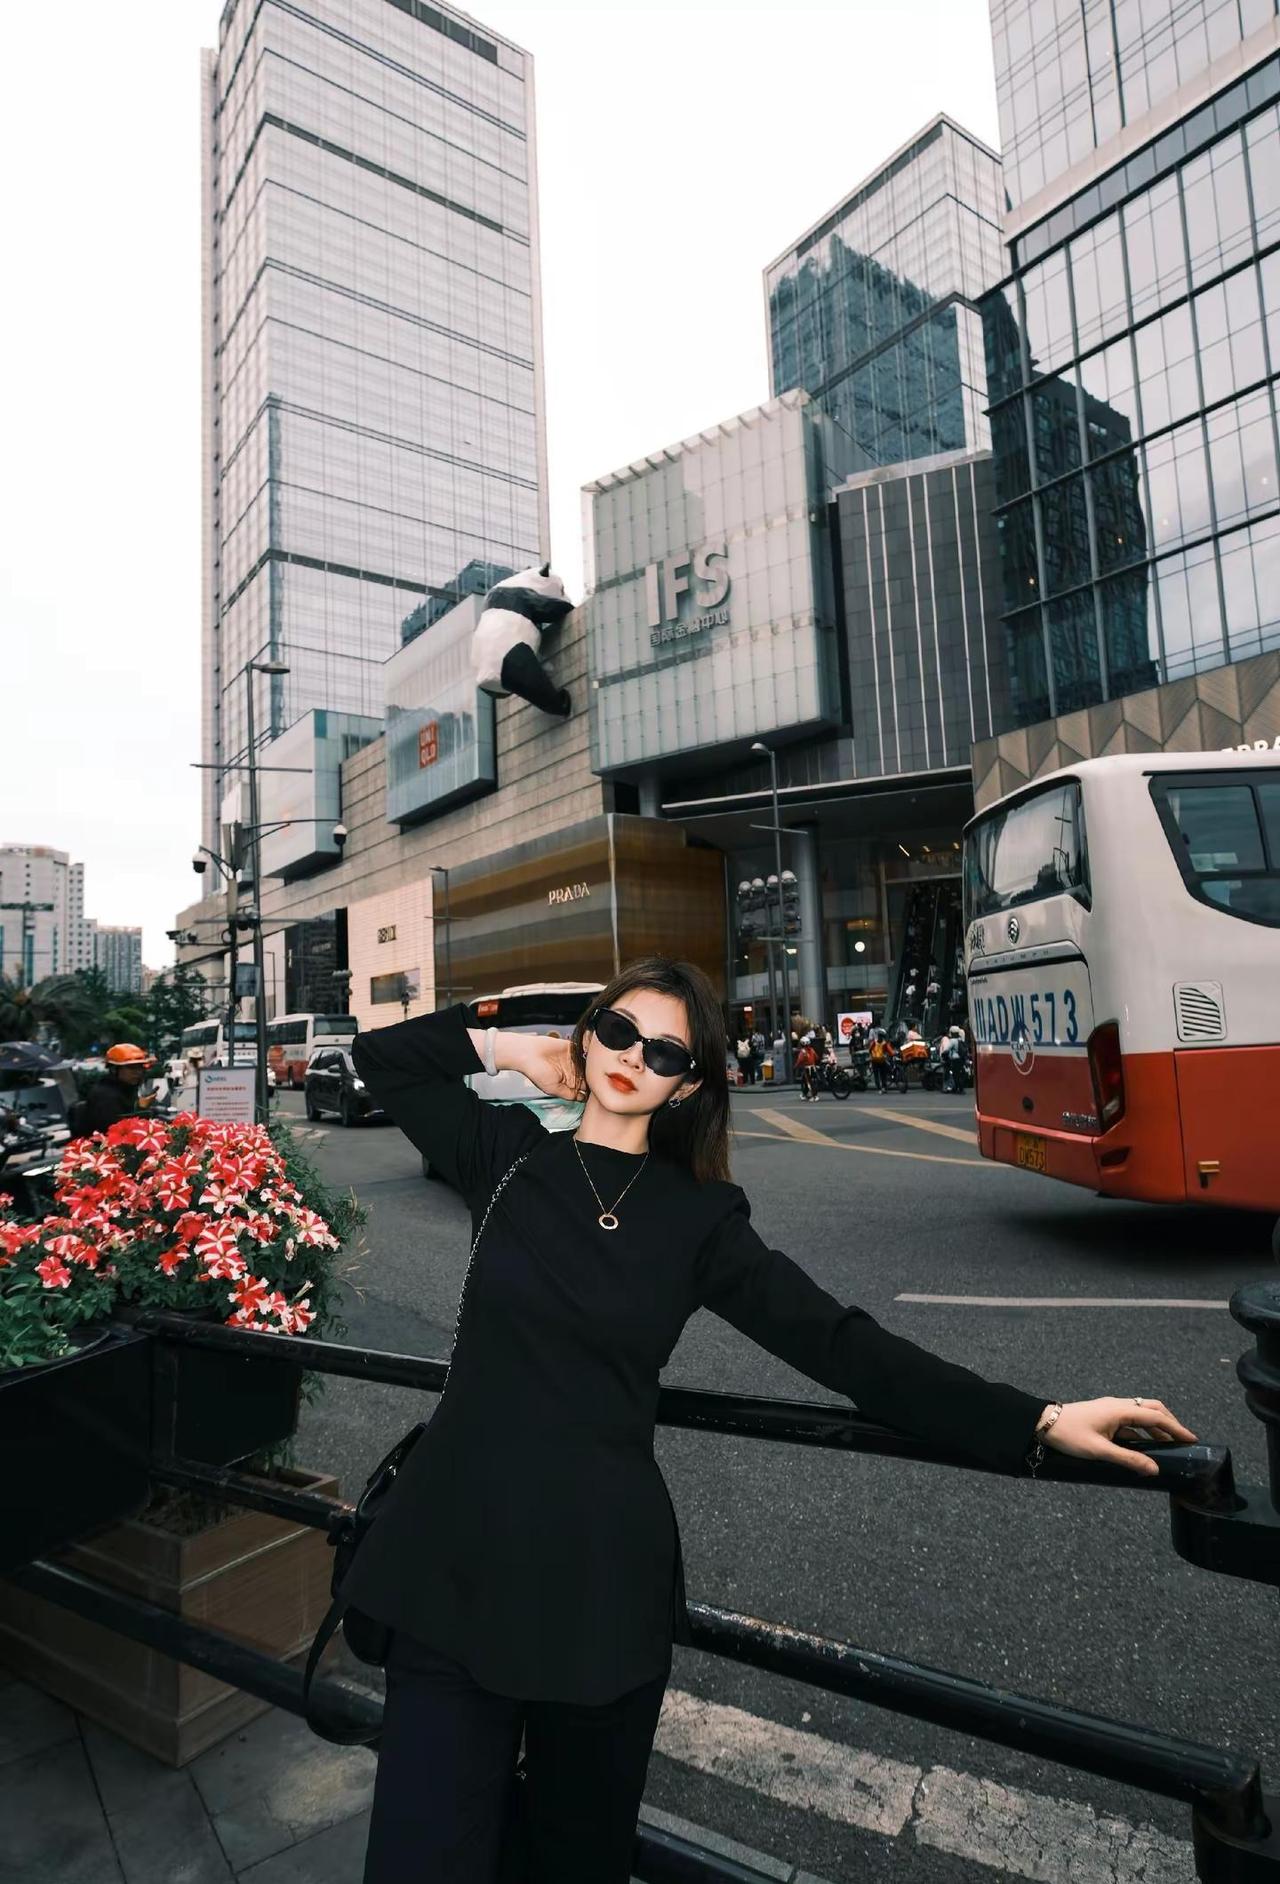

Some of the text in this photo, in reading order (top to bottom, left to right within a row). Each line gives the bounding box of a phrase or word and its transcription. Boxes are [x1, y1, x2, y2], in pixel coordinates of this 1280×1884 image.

[645, 542, 731, 628] IFS
[420, 724, 437, 747] UNI
[420, 743, 437, 765] QLO
[547, 881, 591, 906] PRADA
